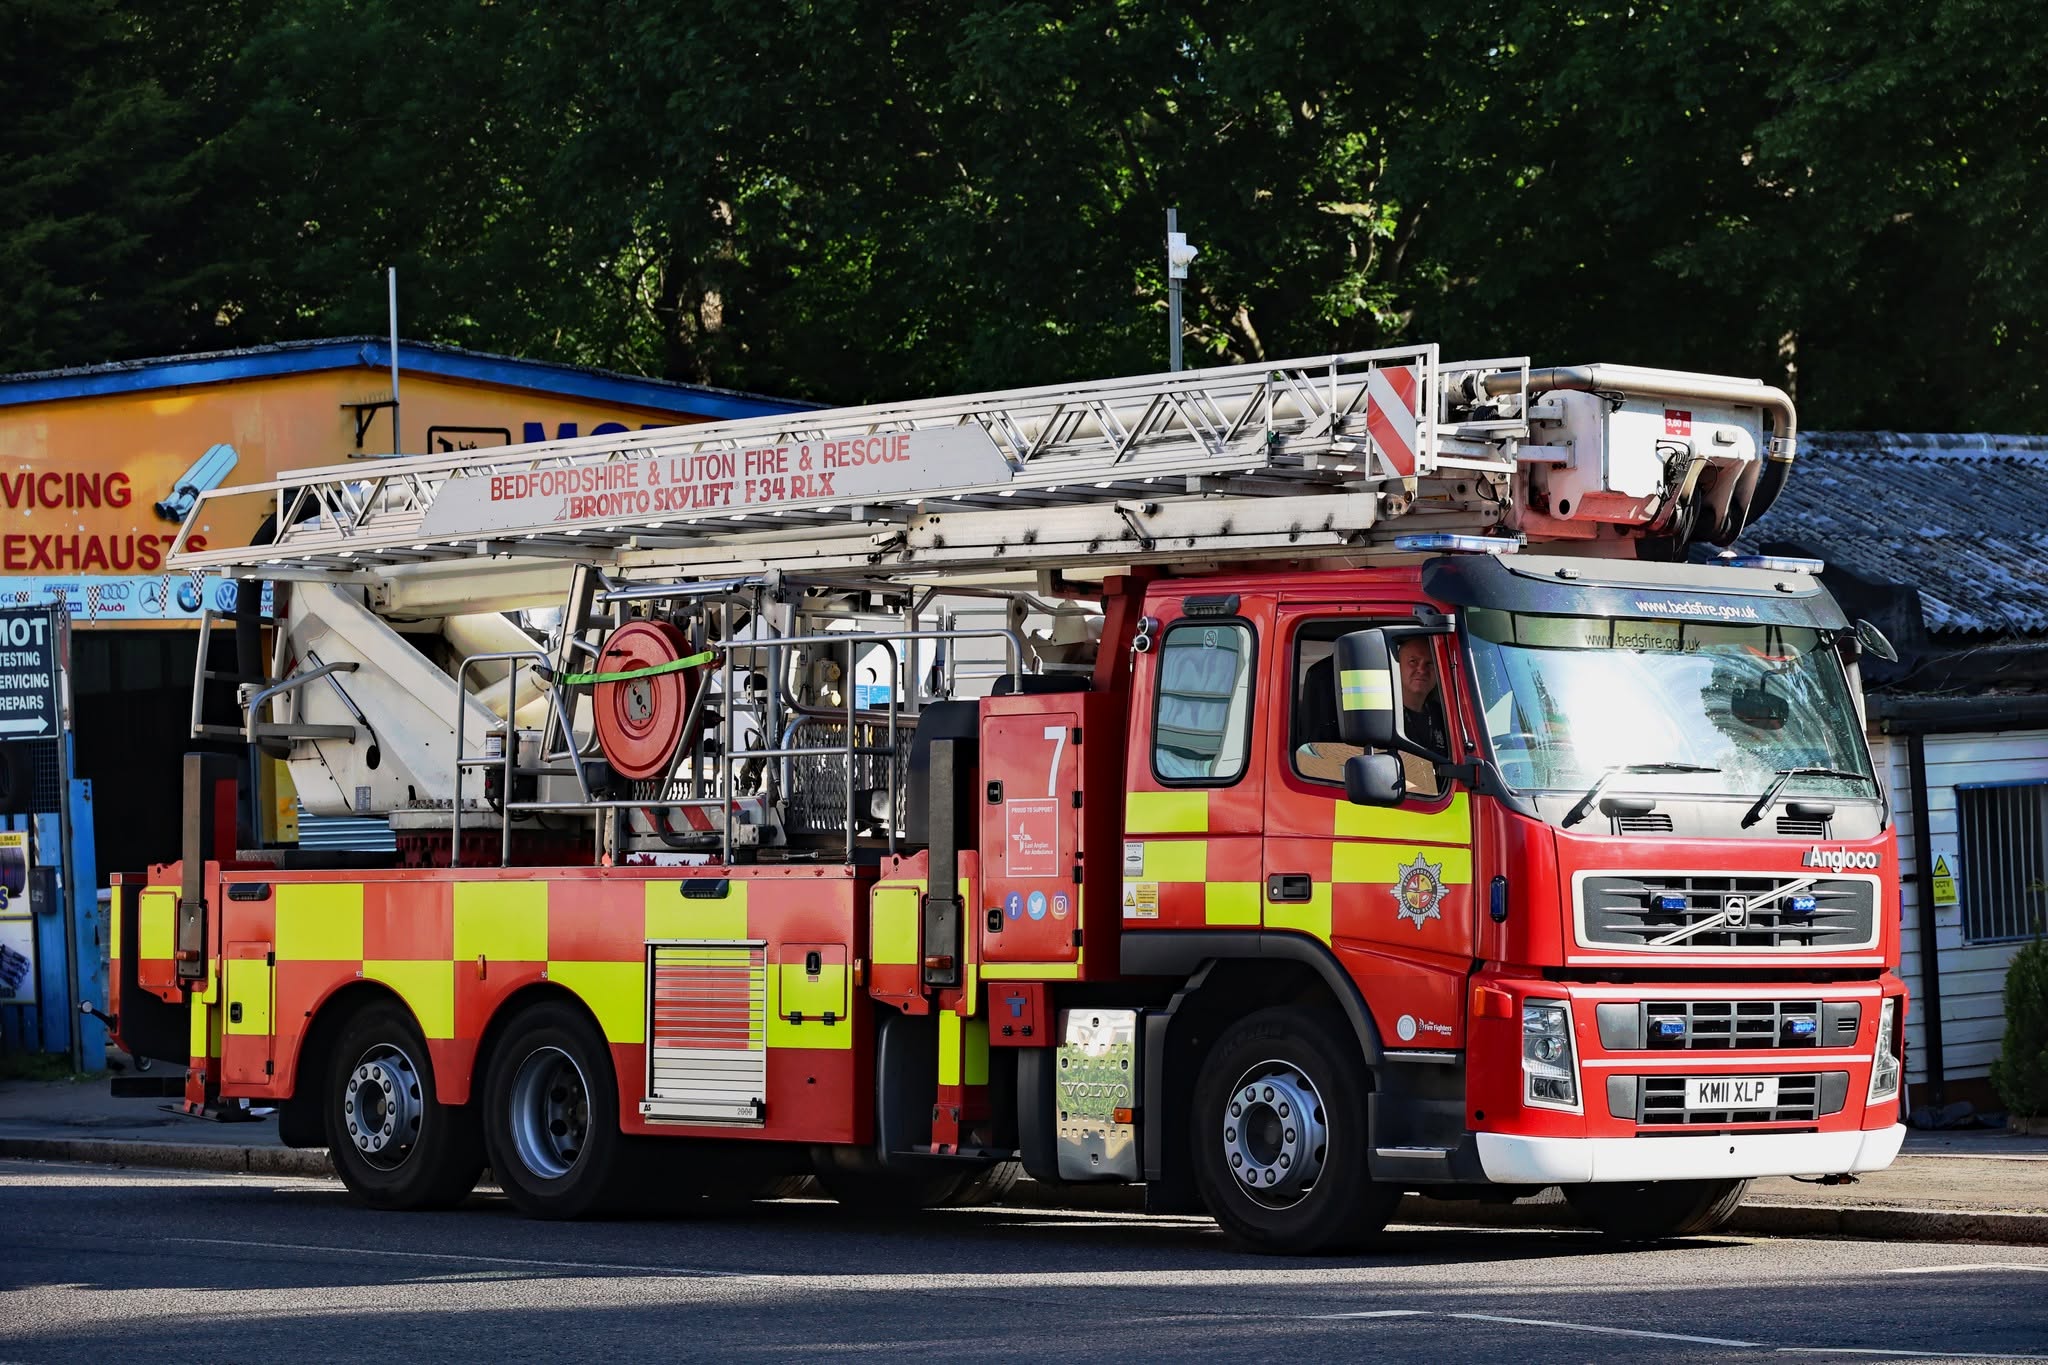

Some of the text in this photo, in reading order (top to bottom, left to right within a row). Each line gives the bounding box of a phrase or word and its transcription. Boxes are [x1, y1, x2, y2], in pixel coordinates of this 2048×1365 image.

[491, 435, 910, 501] BEDFORDSHIRE & LUTON FIRE & RESCUE
[570, 489, 650, 520] BRONTO
[98, 603, 125, 612] Audi
[1636, 600, 1759, 619] www.bedsfire.gov.uk
[1584, 632, 1700, 652] www.bedsfire.go.uk
[0, 695, 44, 711] REPAIRS
[1044, 726, 1067, 797] 7
[1810, 846, 1876, 873] Angloco
[1433, 1024, 1452, 1032] Fighters
[1061, 1082, 1128, 1098] VOLVO
[1700, 1082, 1764, 1103] KM11 XLP
[737, 1107, 753, 1116] 2000
